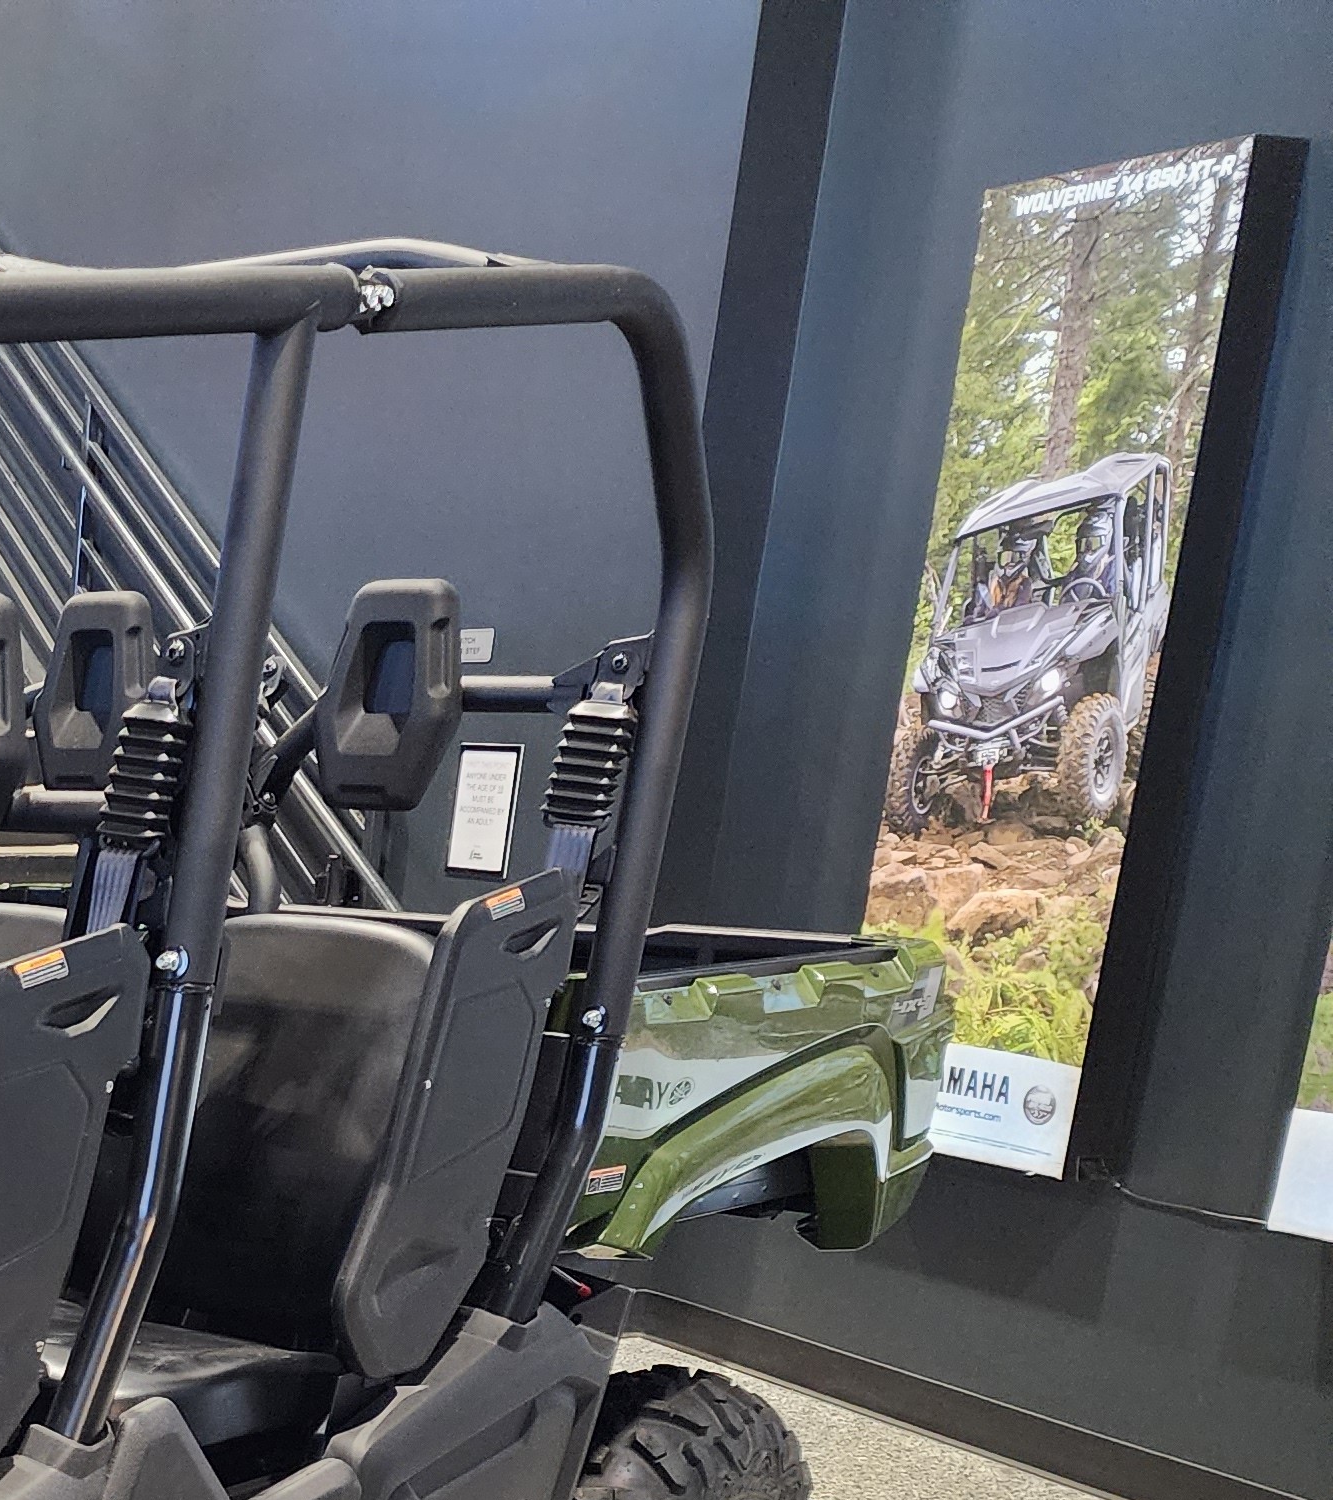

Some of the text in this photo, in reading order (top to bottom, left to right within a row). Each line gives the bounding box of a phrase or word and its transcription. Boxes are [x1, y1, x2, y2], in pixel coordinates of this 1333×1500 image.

[1015, 177, 1118, 216] WOLVERINE
[1146, 165, 1183, 191] 850
[1183, 155, 1237, 189] XT-R
[939, 1065, 1010, 1104] MAHA
